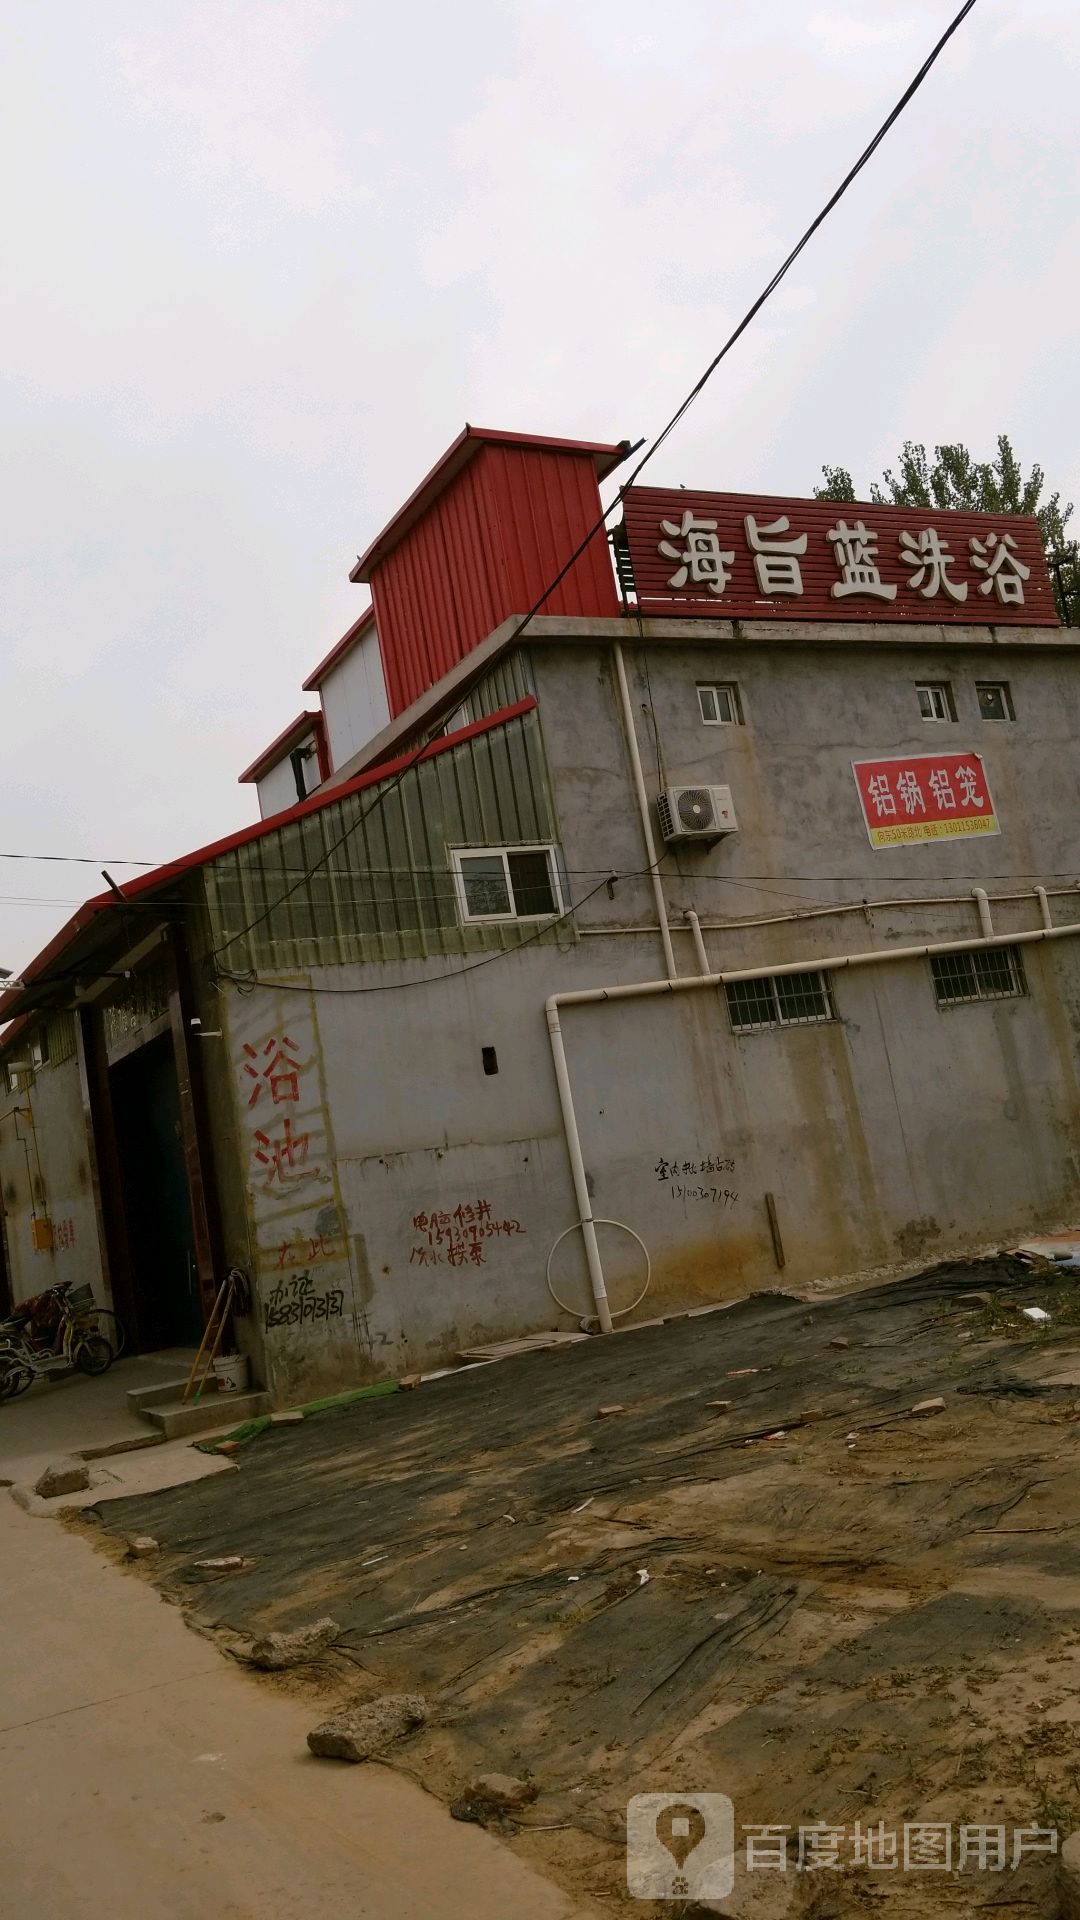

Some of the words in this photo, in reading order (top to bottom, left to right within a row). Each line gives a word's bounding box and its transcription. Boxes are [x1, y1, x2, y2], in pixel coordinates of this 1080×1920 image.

[658, 510, 1030, 605] 海旨蓝洗浴
[867, 765, 984, 817] 铝锅铝笼
[243, 1036, 331, 1184] 浴池
